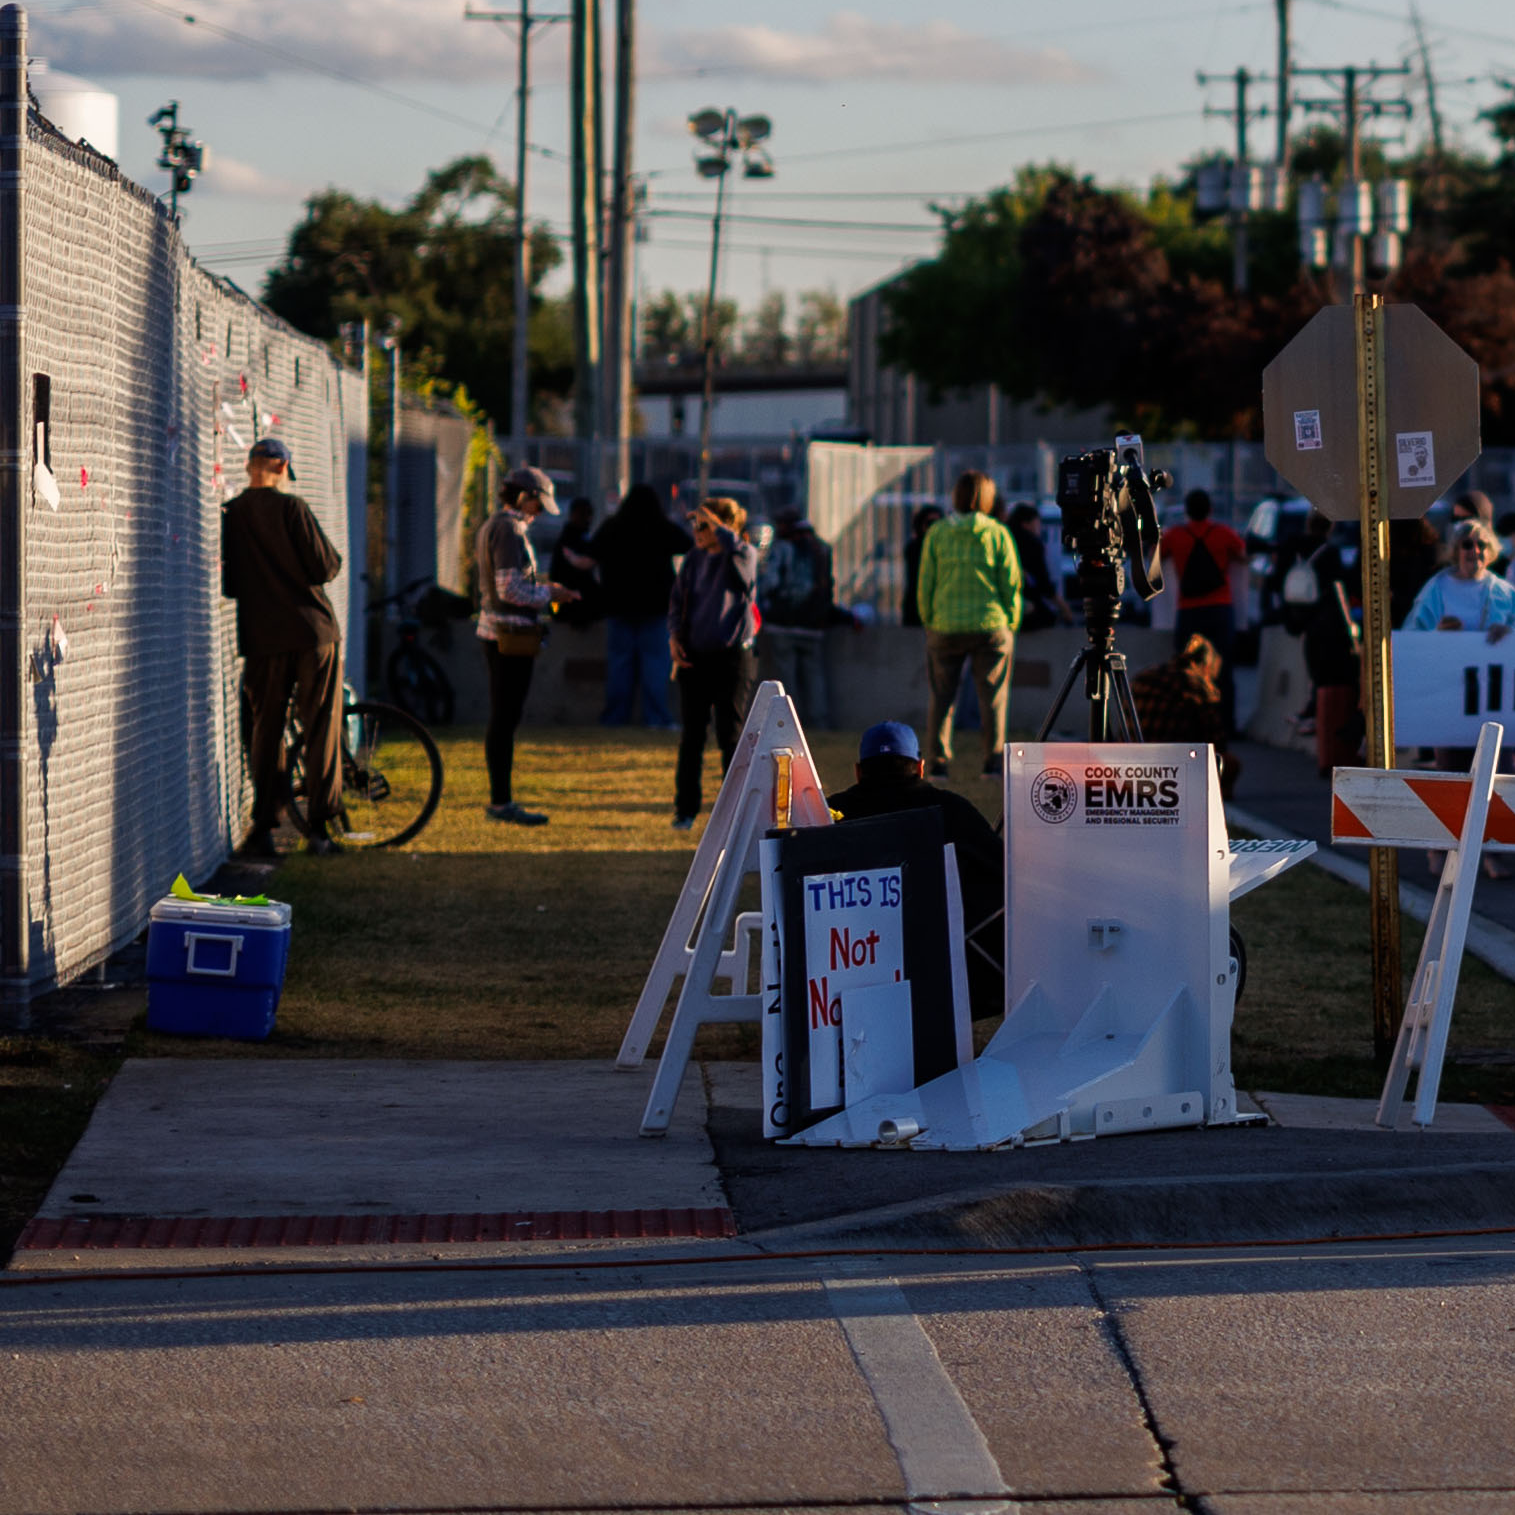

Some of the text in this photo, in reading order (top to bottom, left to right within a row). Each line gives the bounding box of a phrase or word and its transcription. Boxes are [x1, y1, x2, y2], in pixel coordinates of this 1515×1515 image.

[1085, 767, 1179, 779] COOK COUNTY
[1085, 780, 1179, 808] EMRS
[808, 875, 901, 911] THIS IS
[829, 927, 880, 971] Not
